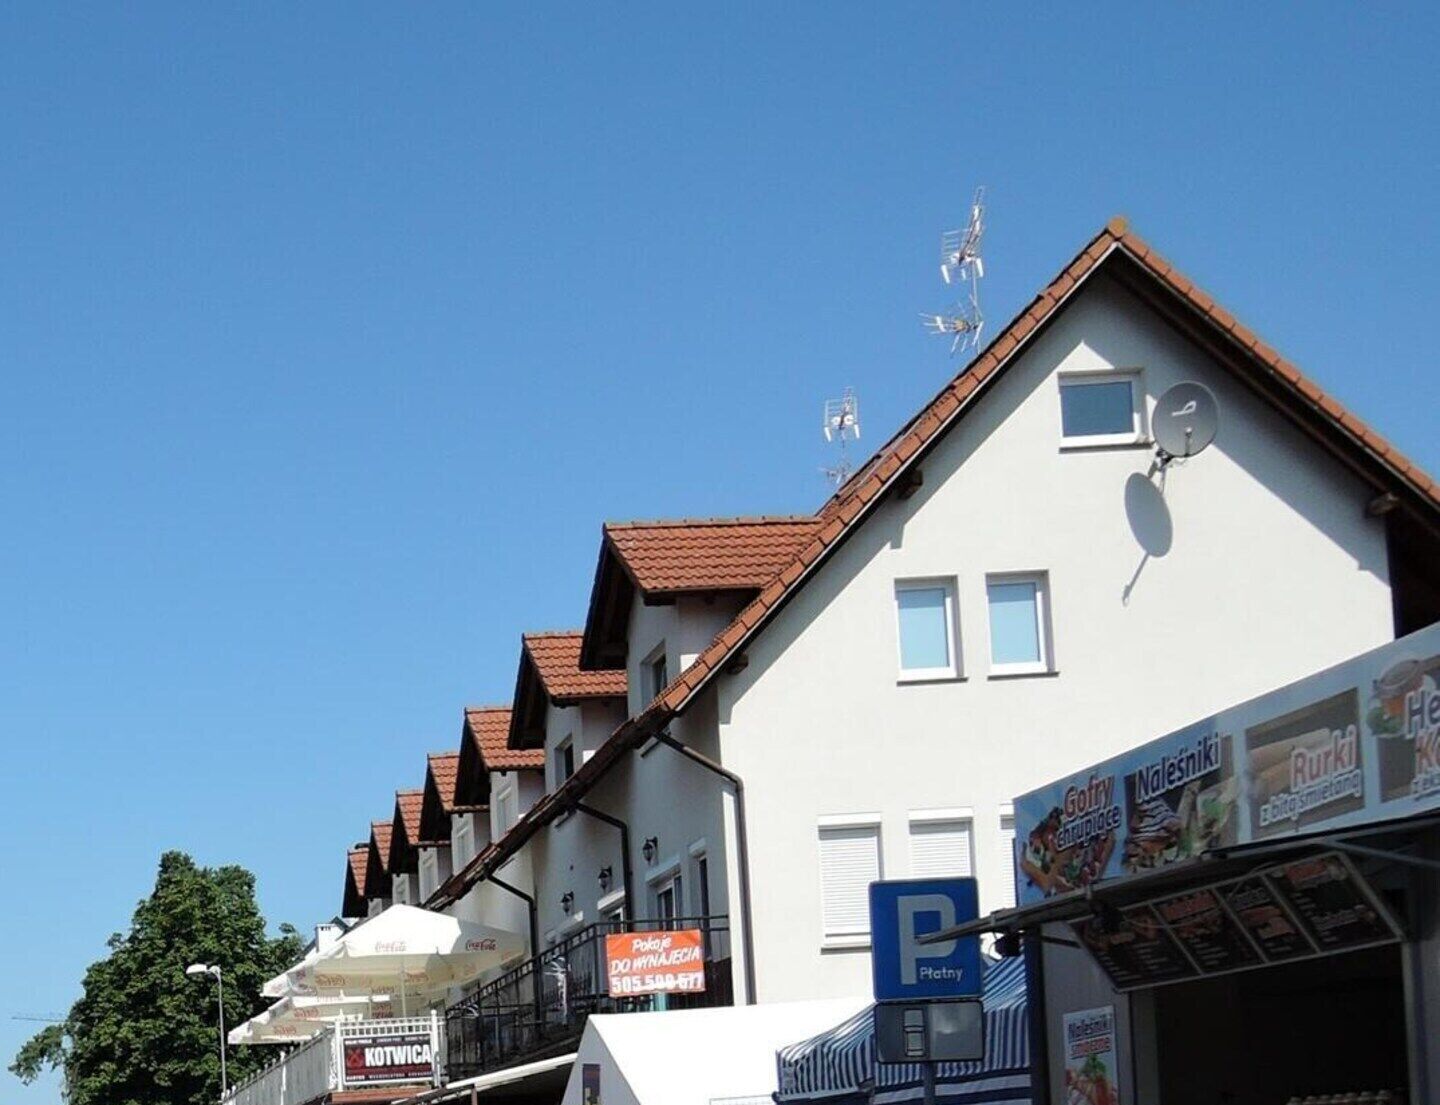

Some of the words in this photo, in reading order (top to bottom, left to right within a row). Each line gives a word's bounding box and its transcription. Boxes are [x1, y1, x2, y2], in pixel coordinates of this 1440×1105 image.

[1137, 732, 1221, 801] Naleśniki
[1292, 725, 1358, 790] Rurki
[1063, 774, 1114, 819] Gofry
[1261, 805, 1271, 825] z
[631, 934, 672, 954] Pokoje
[897, 894, 956, 985] P
[610, 958, 631, 977] DO
[919, 966, 963, 981] Płatny
[364, 1044, 431, 1067] KOTWICA
